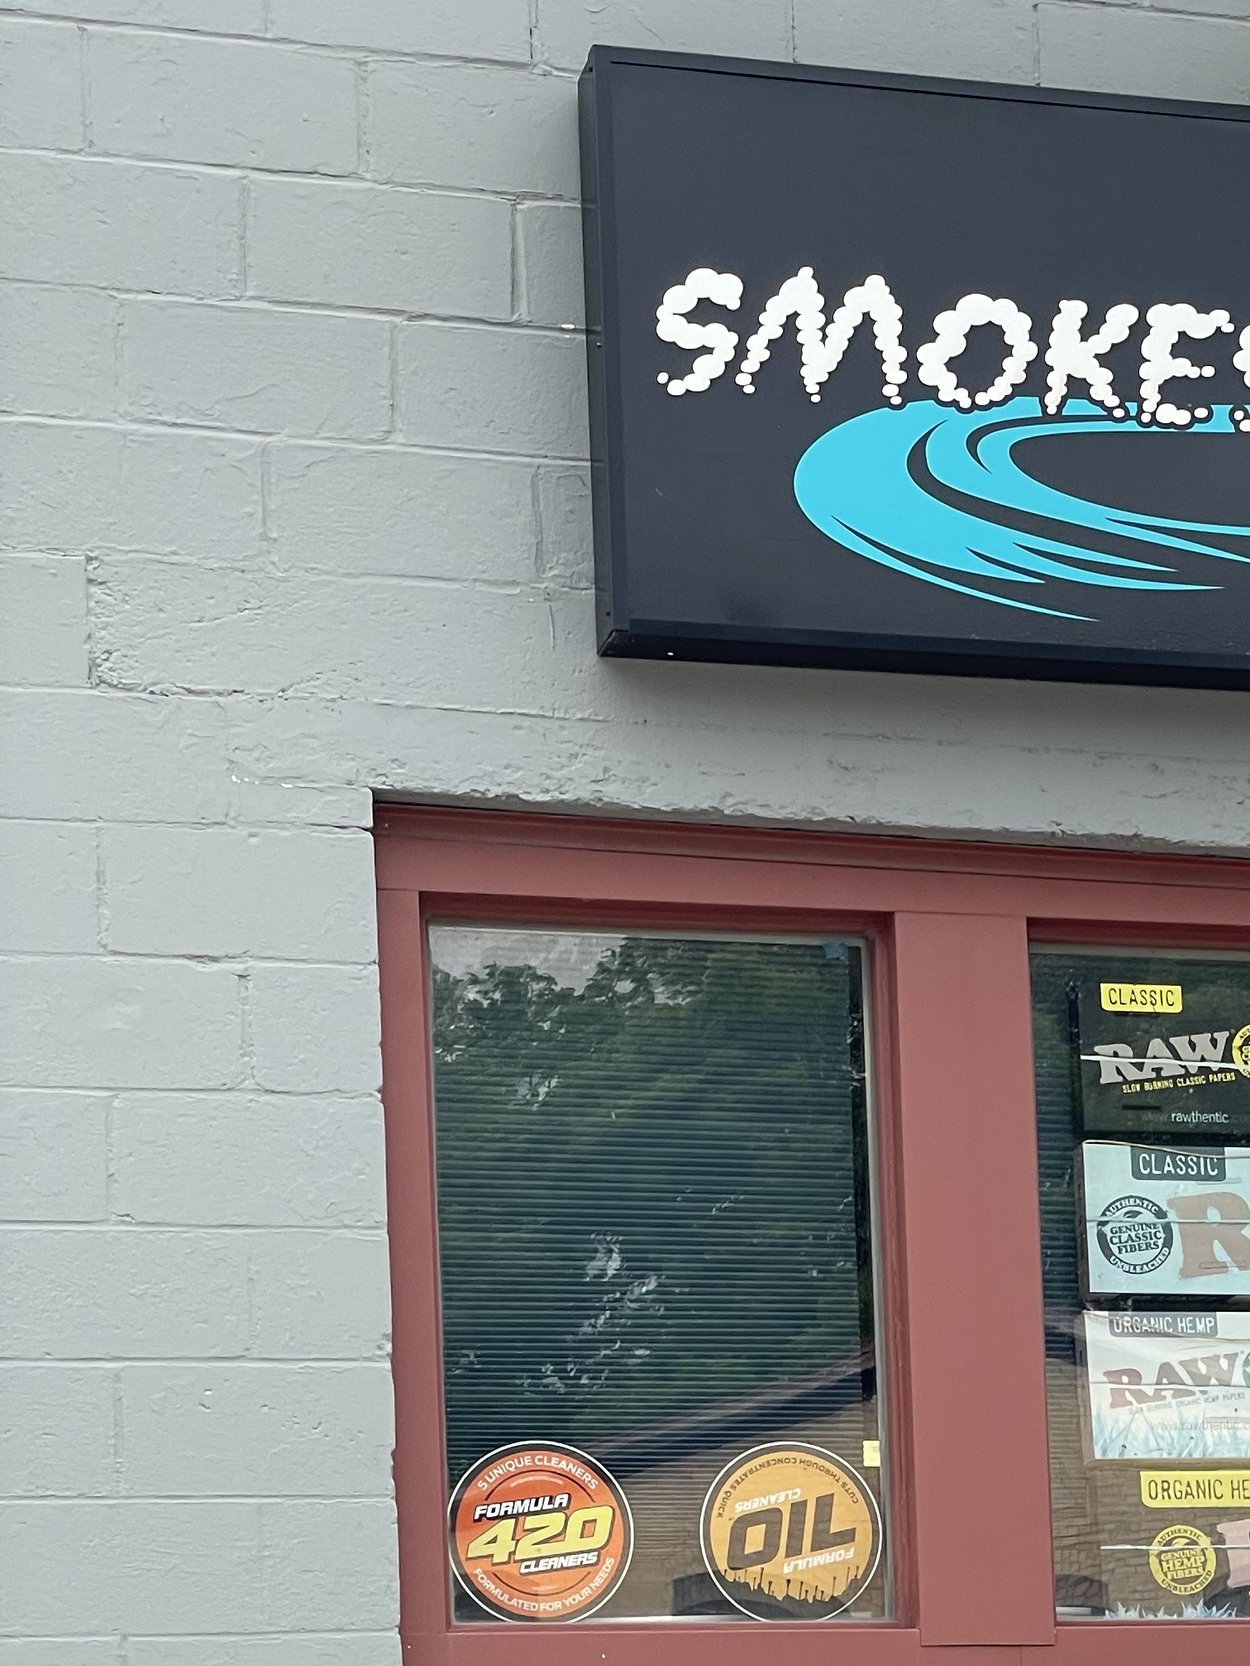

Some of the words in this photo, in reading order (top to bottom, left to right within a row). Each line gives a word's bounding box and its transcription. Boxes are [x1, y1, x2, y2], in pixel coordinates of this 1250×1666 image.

[1108, 988, 1175, 1007] CLASSIC
[1094, 1031, 1230, 1085] RAW
[1122, 1083, 1141, 1094] SLOW
[1144, 1080, 1174, 1091] BURNING
[1176, 1077, 1206, 1088] CLASSIC
[1209, 1072, 1236, 1083] PAPERS
[1138, 1153, 1219, 1176] CLASSIC
[1105, 1198, 1159, 1217] AUTHENTIC
[1109, 1223, 1160, 1236] GENUINE
[1109, 1231, 1163, 1246] CLASSIC
[1117, 1240, 1160, 1255] FIBERS
[1109, 1247, 1170, 1275] UNBLEACHED
[1113, 1316, 1173, 1333] ORGANIC
[1177, 1316, 1216, 1333] HEMP
[1103, 1352, 1239, 1410] RAW
[476, 1481, 488, 1492] 5
[485, 1455, 533, 1481] UNIQUE
[534, 1455, 599, 1490] CLEANERS
[731, 1457, 797, 1491] CONCENTRATES
[734, 1488, 802, 1513] CLEANERS
[1147, 1479, 1224, 1500] ORGANIC
[474, 1493, 570, 1520] FORMULA
[716, 1490, 733, 1519] QUICK
[466, 1505, 615, 1564] 420
[1156, 1528, 1203, 1545] AUTHENTIC
[520, 1551, 599, 1574] CLEANERS
[1162, 1555, 1206, 1573] HEMP
[1167, 1566, 1204, 1580] FIBERS
[473, 1567, 539, 1612] FORMULATED
[540, 1600, 563, 1612] FOR
[563, 1586, 593, 1607] YOUR
[591, 1556, 615, 1590] NEEDS
[1161, 1570, 1213, 1594] UNBLEACHED
